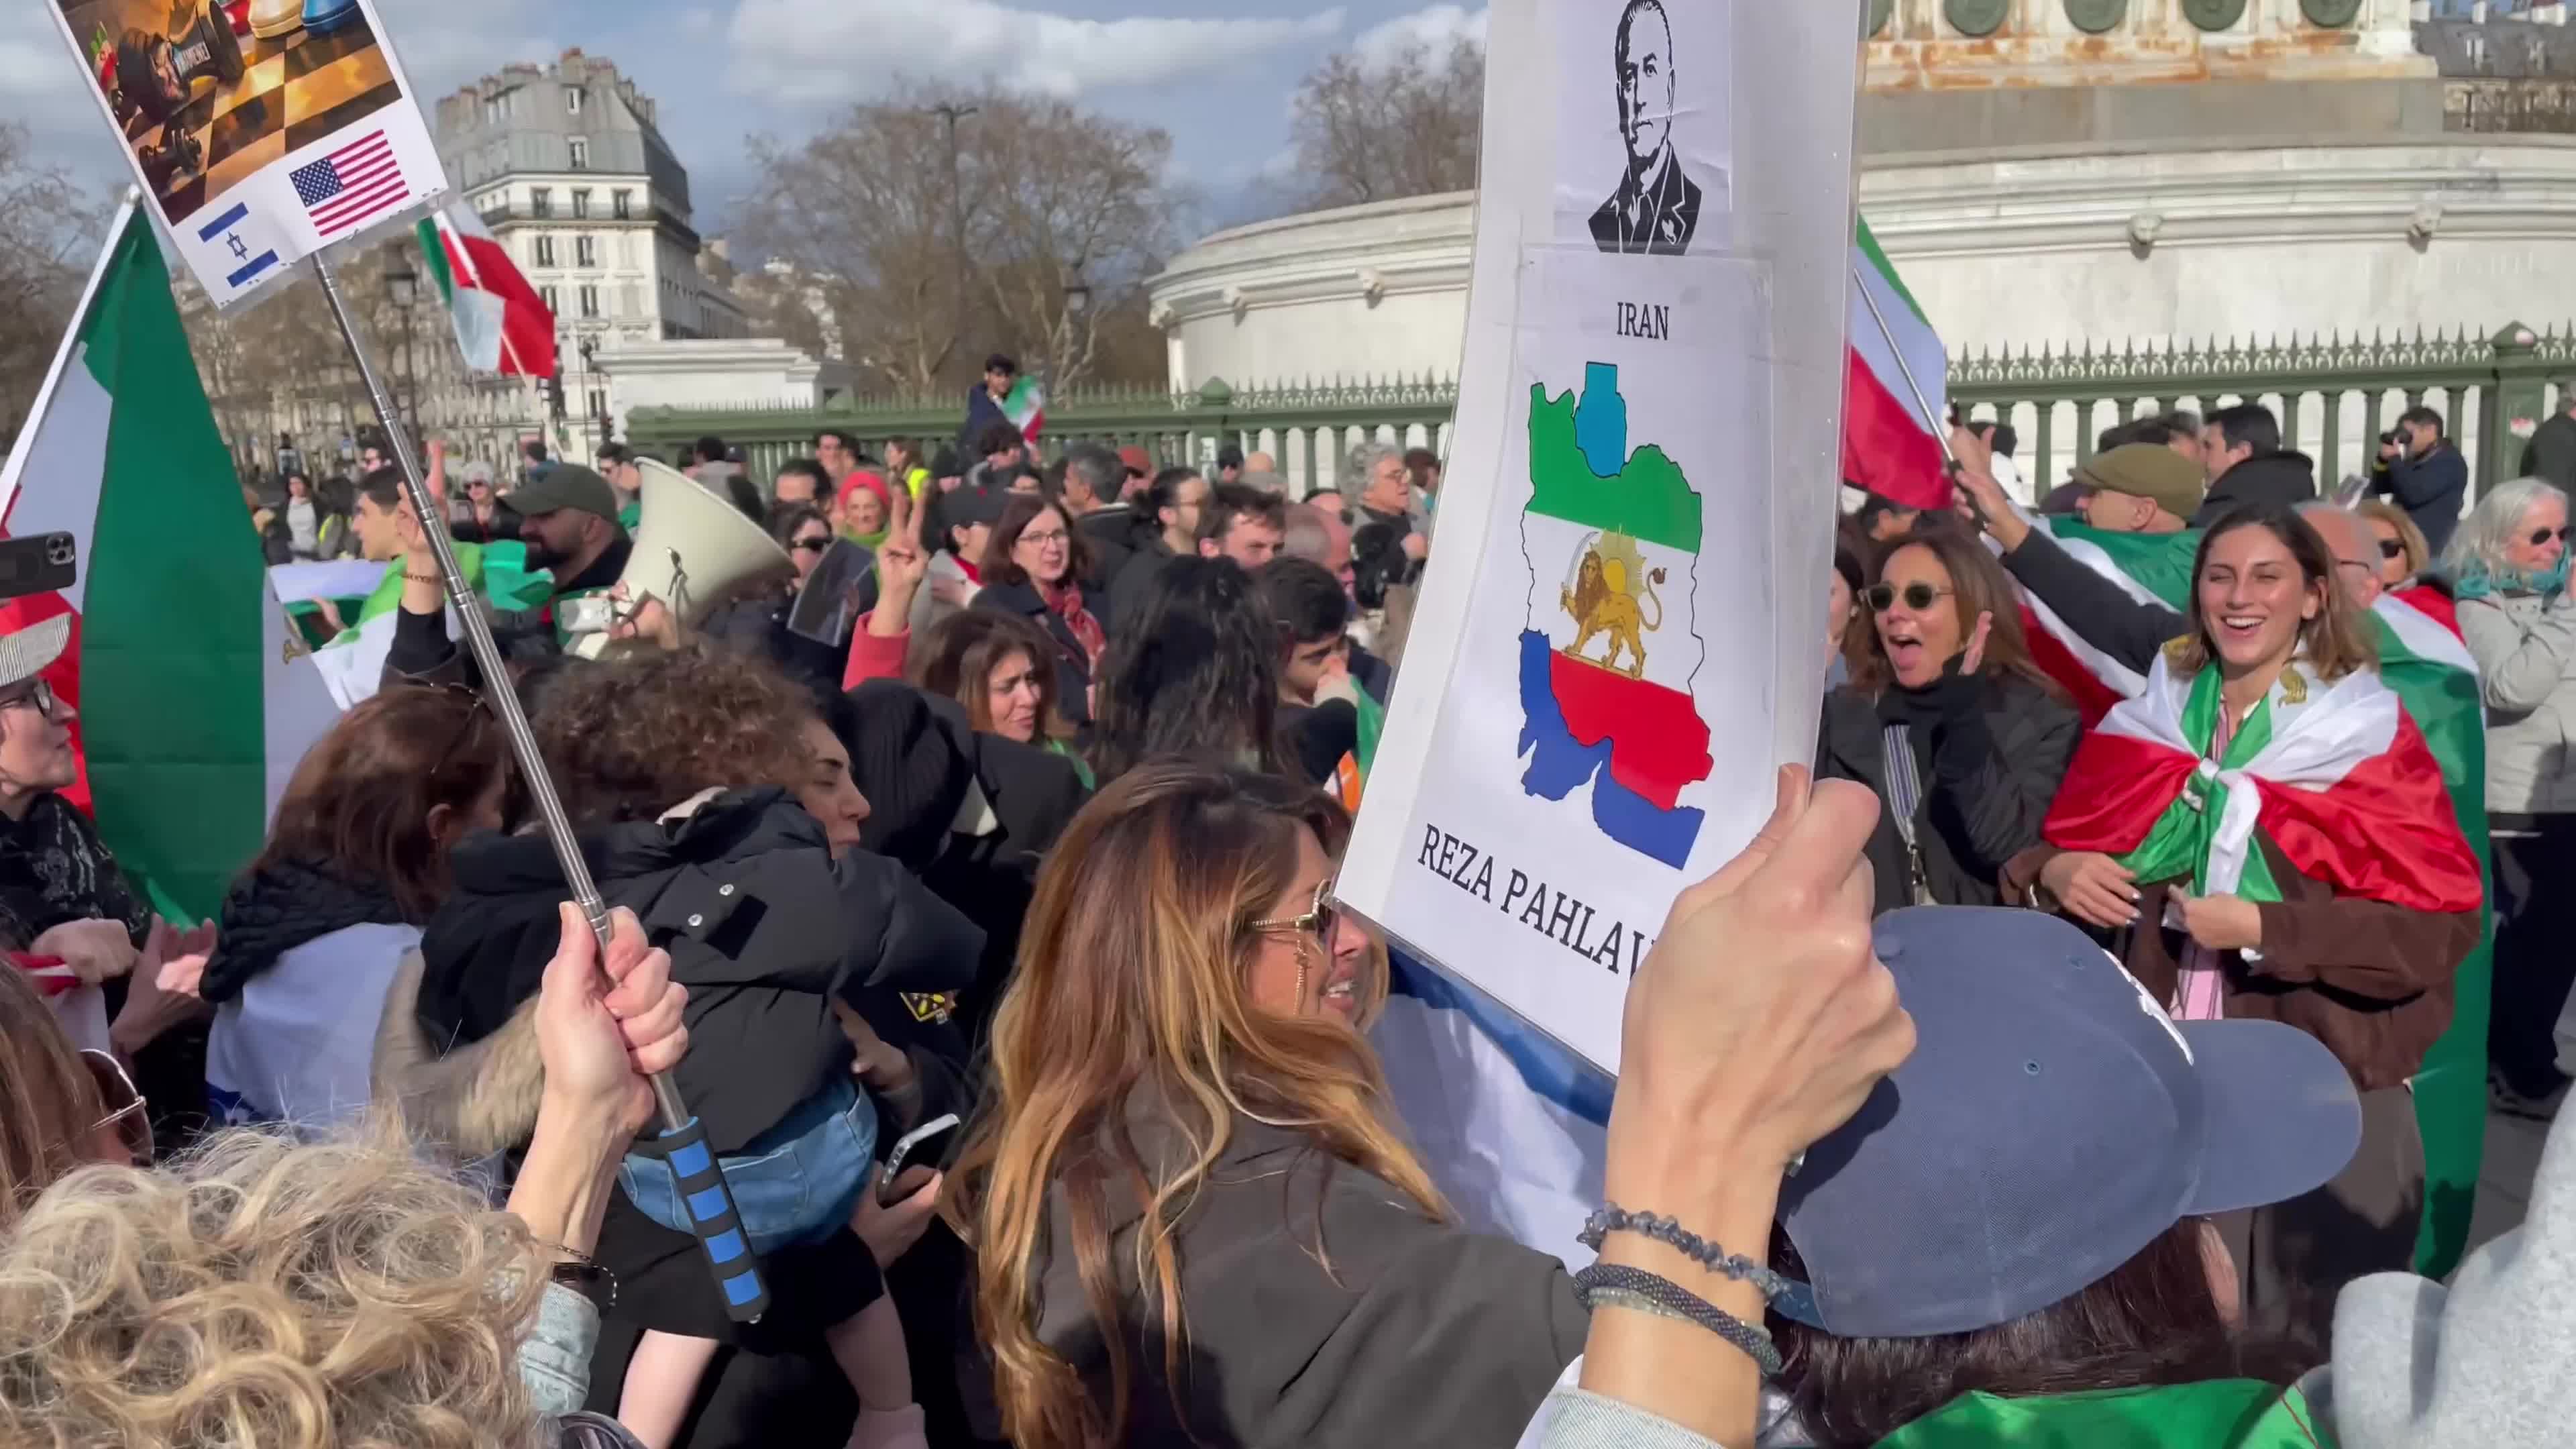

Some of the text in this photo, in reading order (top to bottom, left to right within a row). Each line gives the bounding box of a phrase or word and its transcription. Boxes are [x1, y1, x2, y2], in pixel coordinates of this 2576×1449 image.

[1617, 302, 1669, 340] IRAN
[1417, 823, 1654, 980] REZA PAHLAV
